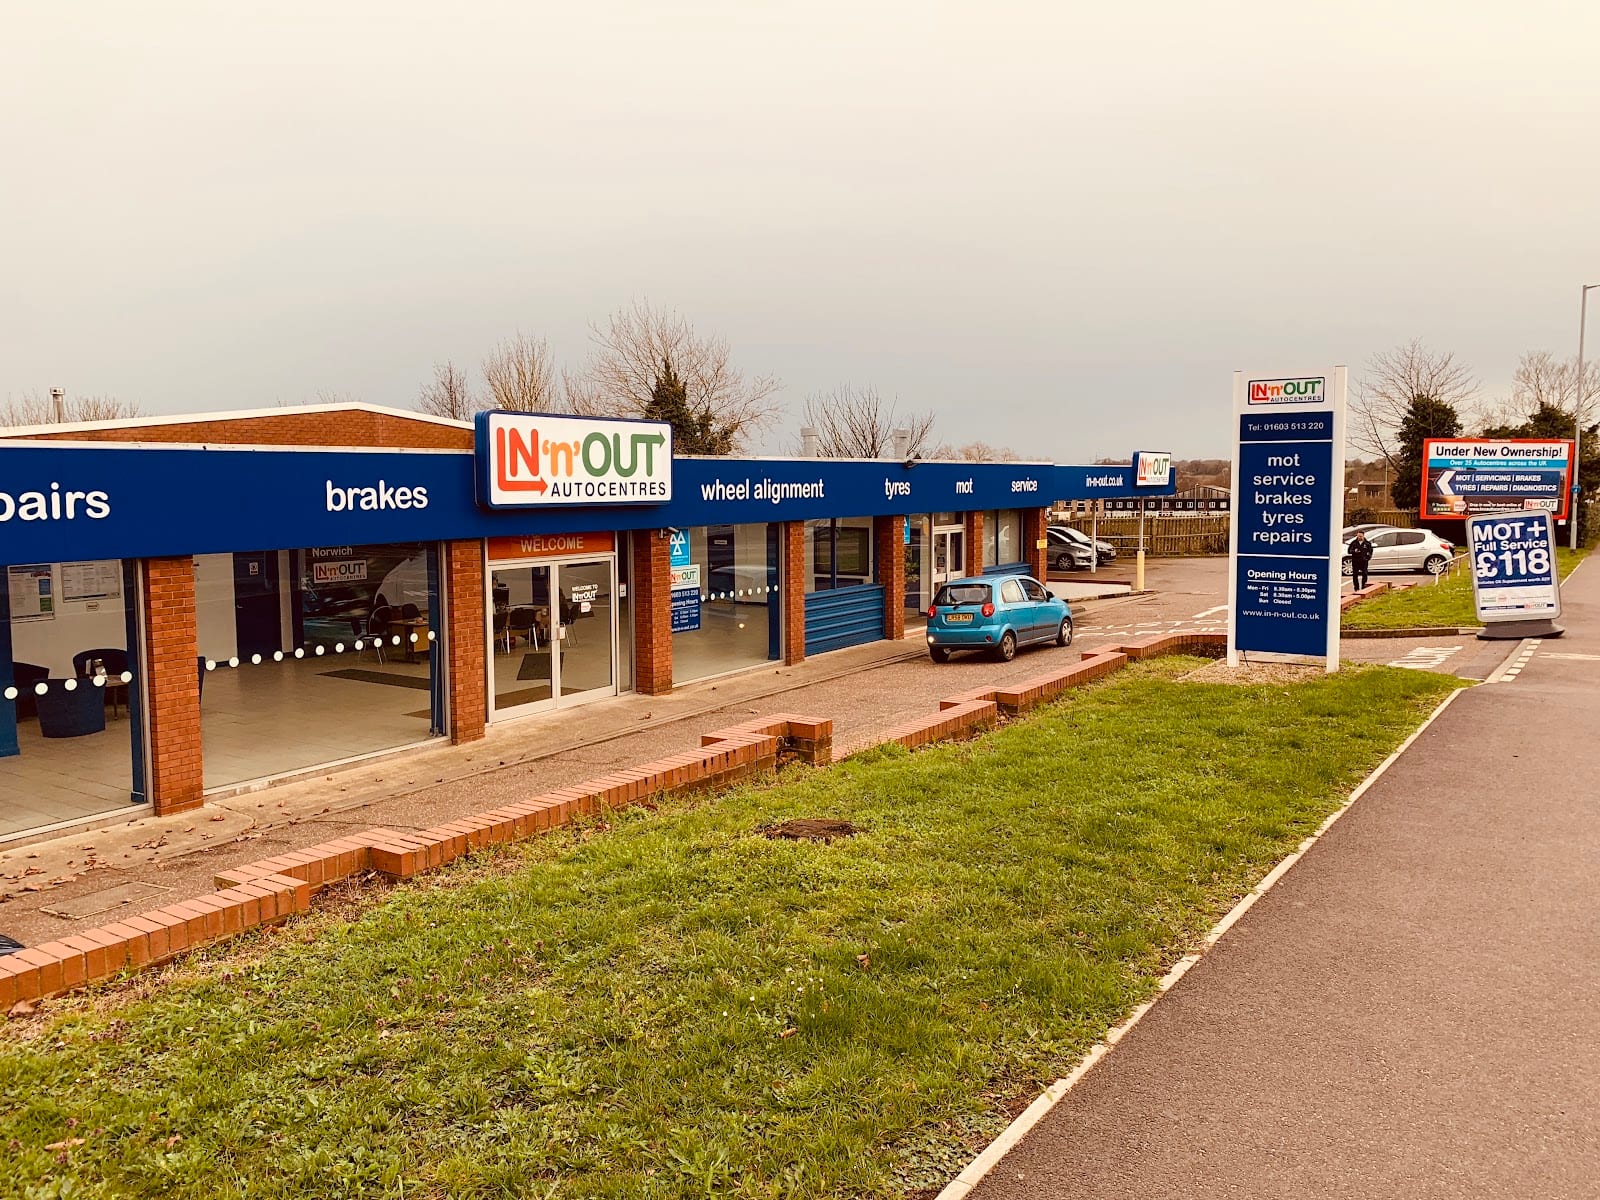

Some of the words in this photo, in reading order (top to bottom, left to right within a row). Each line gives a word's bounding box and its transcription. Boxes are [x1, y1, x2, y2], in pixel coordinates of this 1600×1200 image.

[1248, 423, 1262, 431] Tel:
[1264, 422, 1289, 431] 01603
[1291, 422, 1307, 430] 513
[1308, 422, 1324, 430] 220
[1436, 446, 1471, 457] Under
[1473, 446, 1497, 457] New
[1501, 446, 1562, 459] Ownership!
[1267, 453, 1300, 467] mot
[1011, 477, 1038, 493] service
[1085, 474, 1124, 488] in-n-out.co.uk
[1253, 472, 1316, 486] service
[1455, 474, 1471, 482] MOT
[1475, 474, 1511, 482] SERVICING
[1515, 474, 1542, 482] BRAKES
[551, 482, 666, 497] AUTOCENTRES
[701, 478, 750, 501] wheel
[753, 478, 825, 504] alignment
[885, 478, 911, 500] tyres
[956, 478, 973, 494] mot
[1480, 484, 1508, 492] REPAIRS
[1512, 484, 1557, 492] DIAGNOSTICS
[326, 479, 429, 512] brakes
[1255, 491, 1313, 505] brakes
[1262, 510, 1304, 527] tyres
[1252, 529, 1313, 545] repairs
[1473, 522, 1524, 541] MOT
[1526, 521, 1546, 537] +
[520, 536, 584, 553] WELCOME
[1474, 541, 1497, 552] Full
[1500, 538, 1548, 551] Service
[312, 546, 353, 558] Norwich
[1476, 548, 1550, 578] £118
[1247, 569, 1287, 581] Opening
[1288, 570, 1318, 580] Hours
[1242, 609, 1320, 620] www.in-n-out.co.uk
